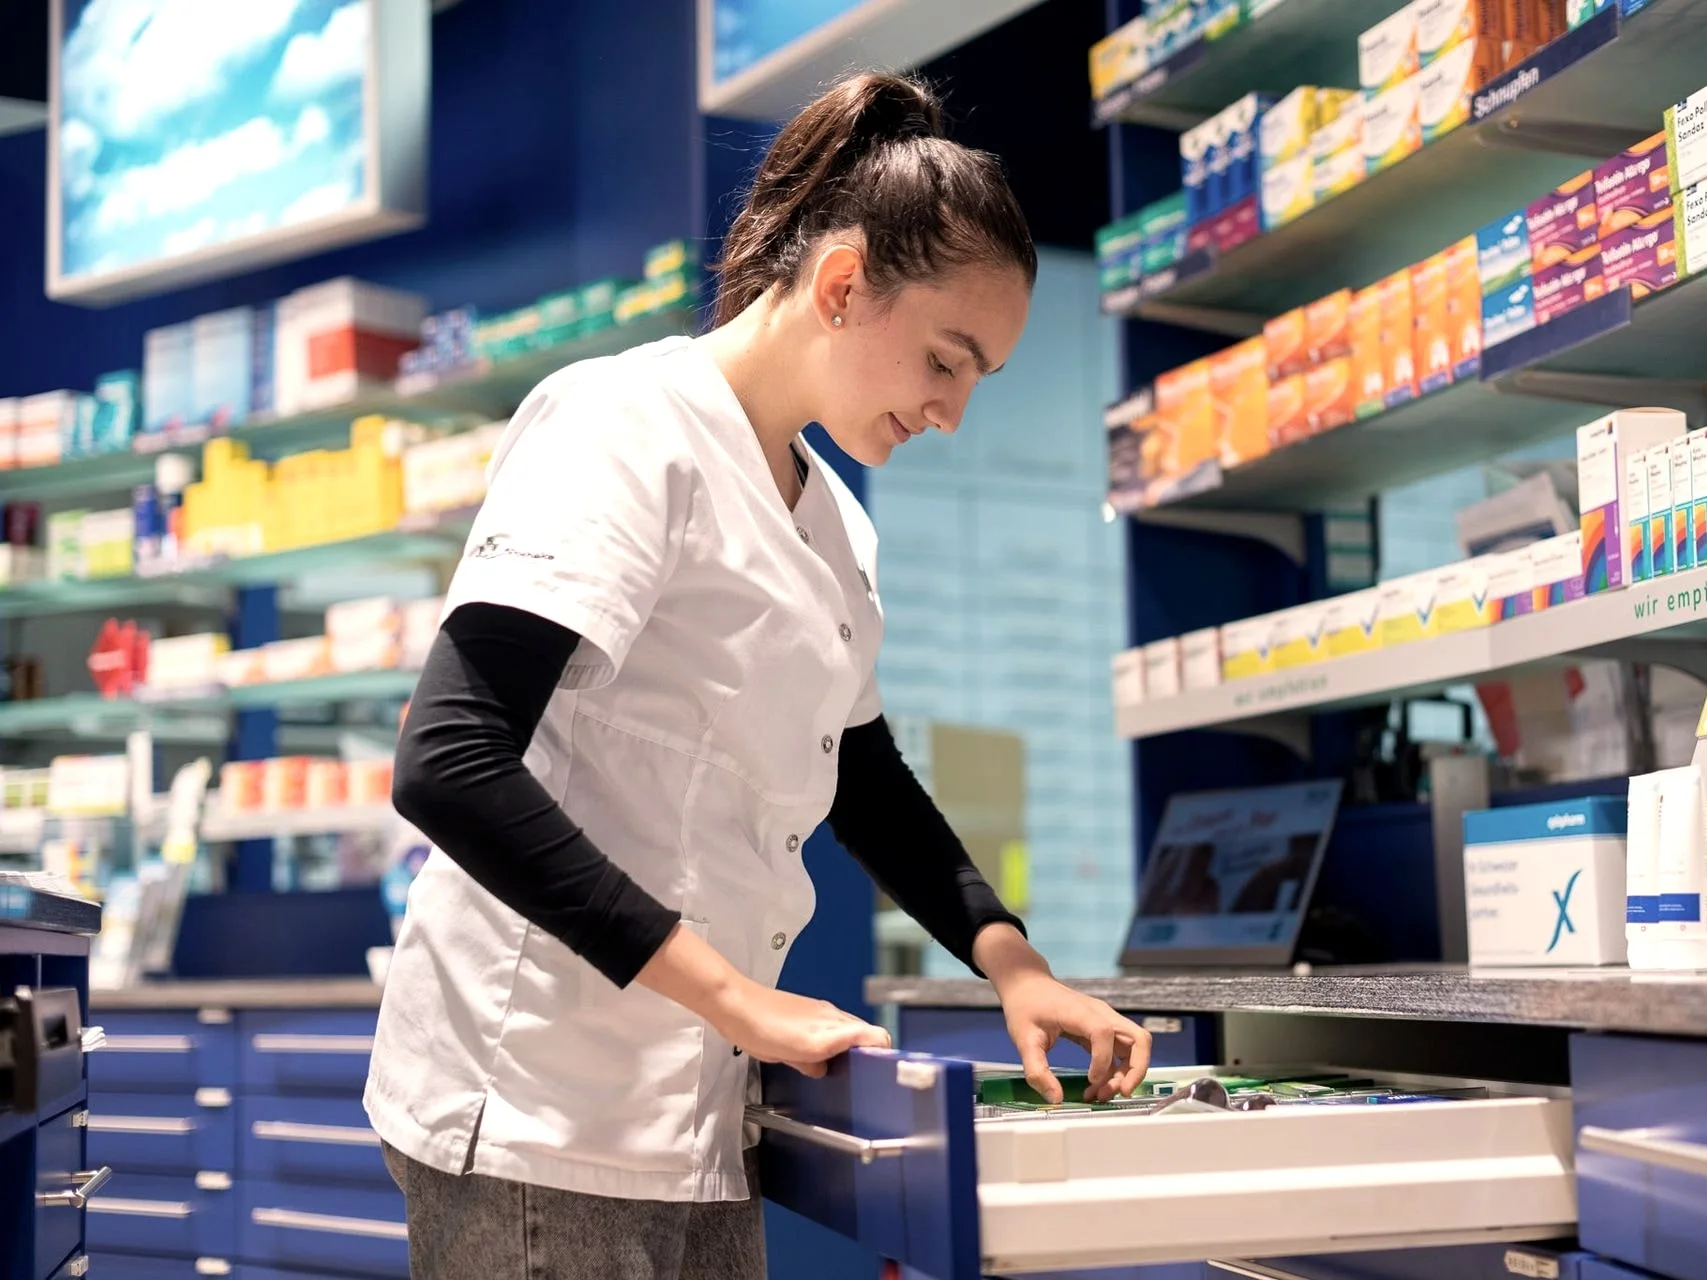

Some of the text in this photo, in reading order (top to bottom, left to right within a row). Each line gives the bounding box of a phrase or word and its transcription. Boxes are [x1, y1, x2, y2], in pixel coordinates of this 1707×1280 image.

[1474, 67, 1539, 119] Schnupfen
[1677, 113, 1694, 129] Fexo
[1678, 121, 1704, 143] Sandoz
[1686, 196, 1703, 212] Fexo
[1634, 593, 1658, 619] wir
